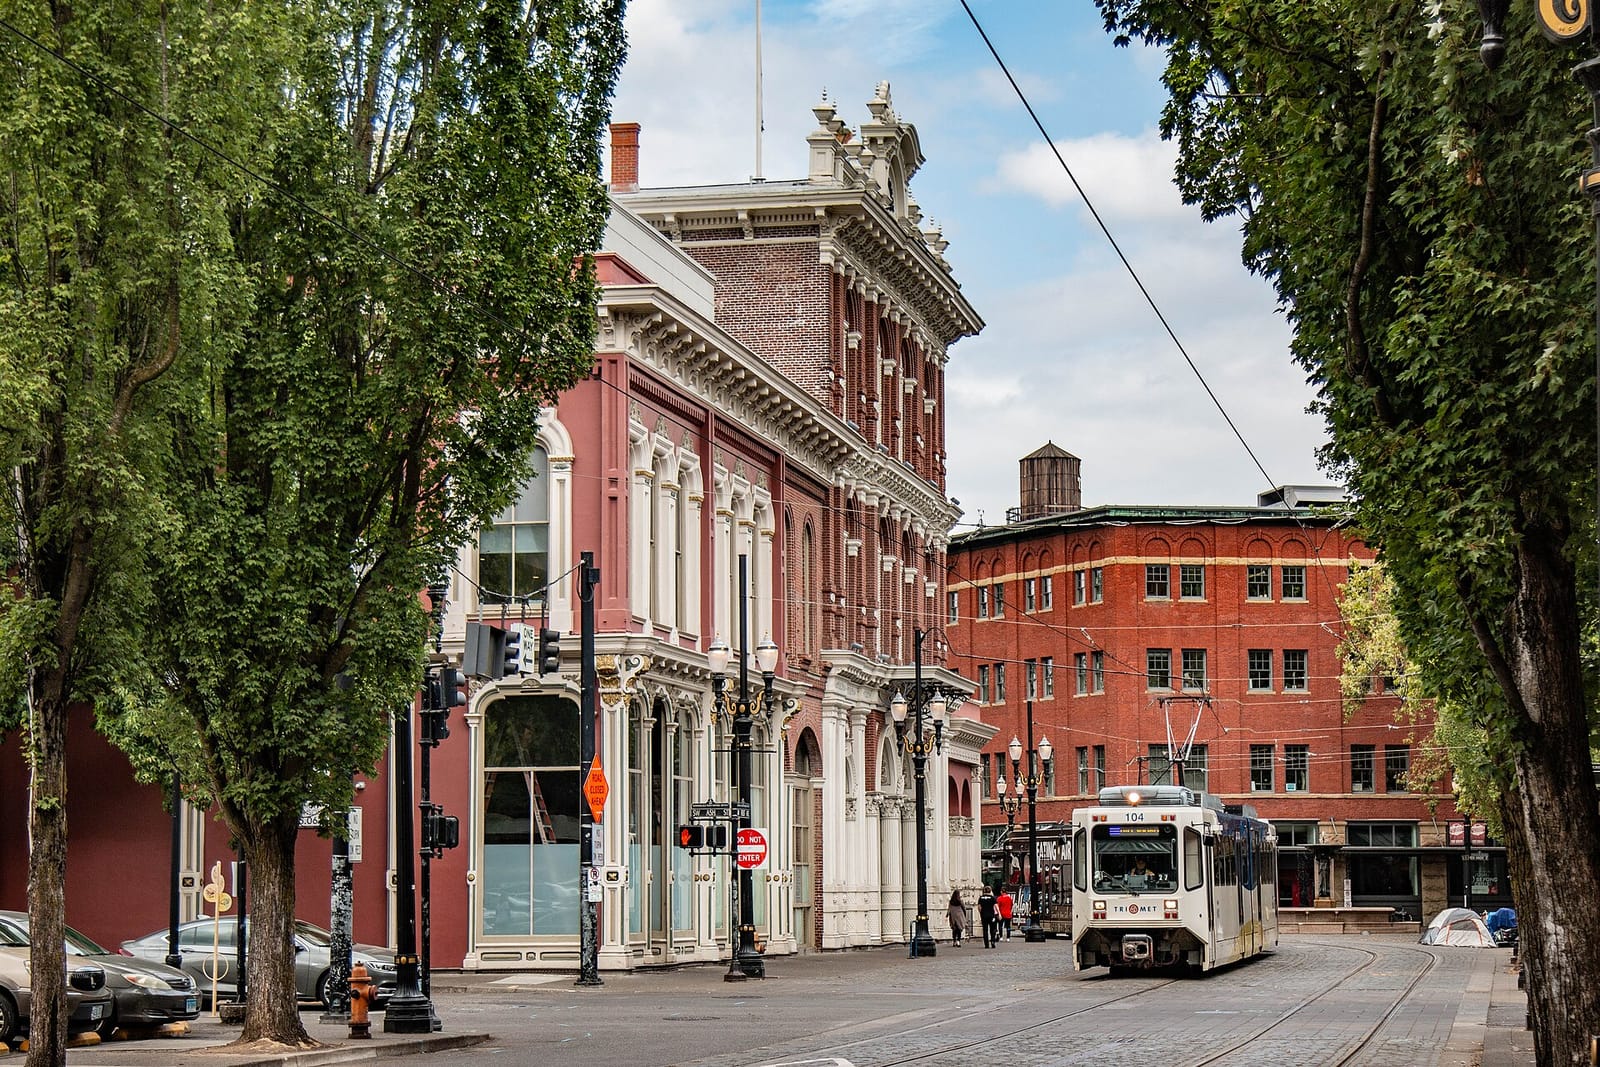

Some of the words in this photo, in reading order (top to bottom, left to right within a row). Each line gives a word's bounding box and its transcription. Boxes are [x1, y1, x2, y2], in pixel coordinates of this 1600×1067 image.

[524, 627, 534, 640] ONE
[523, 640, 534, 652] WAY
[590, 785, 605, 795] CLOSED
[706, 809, 716, 817] ASH
[1125, 812, 1144, 822] 104
[749, 836, 762, 844] NOT
[738, 854, 761, 862] ENTER
